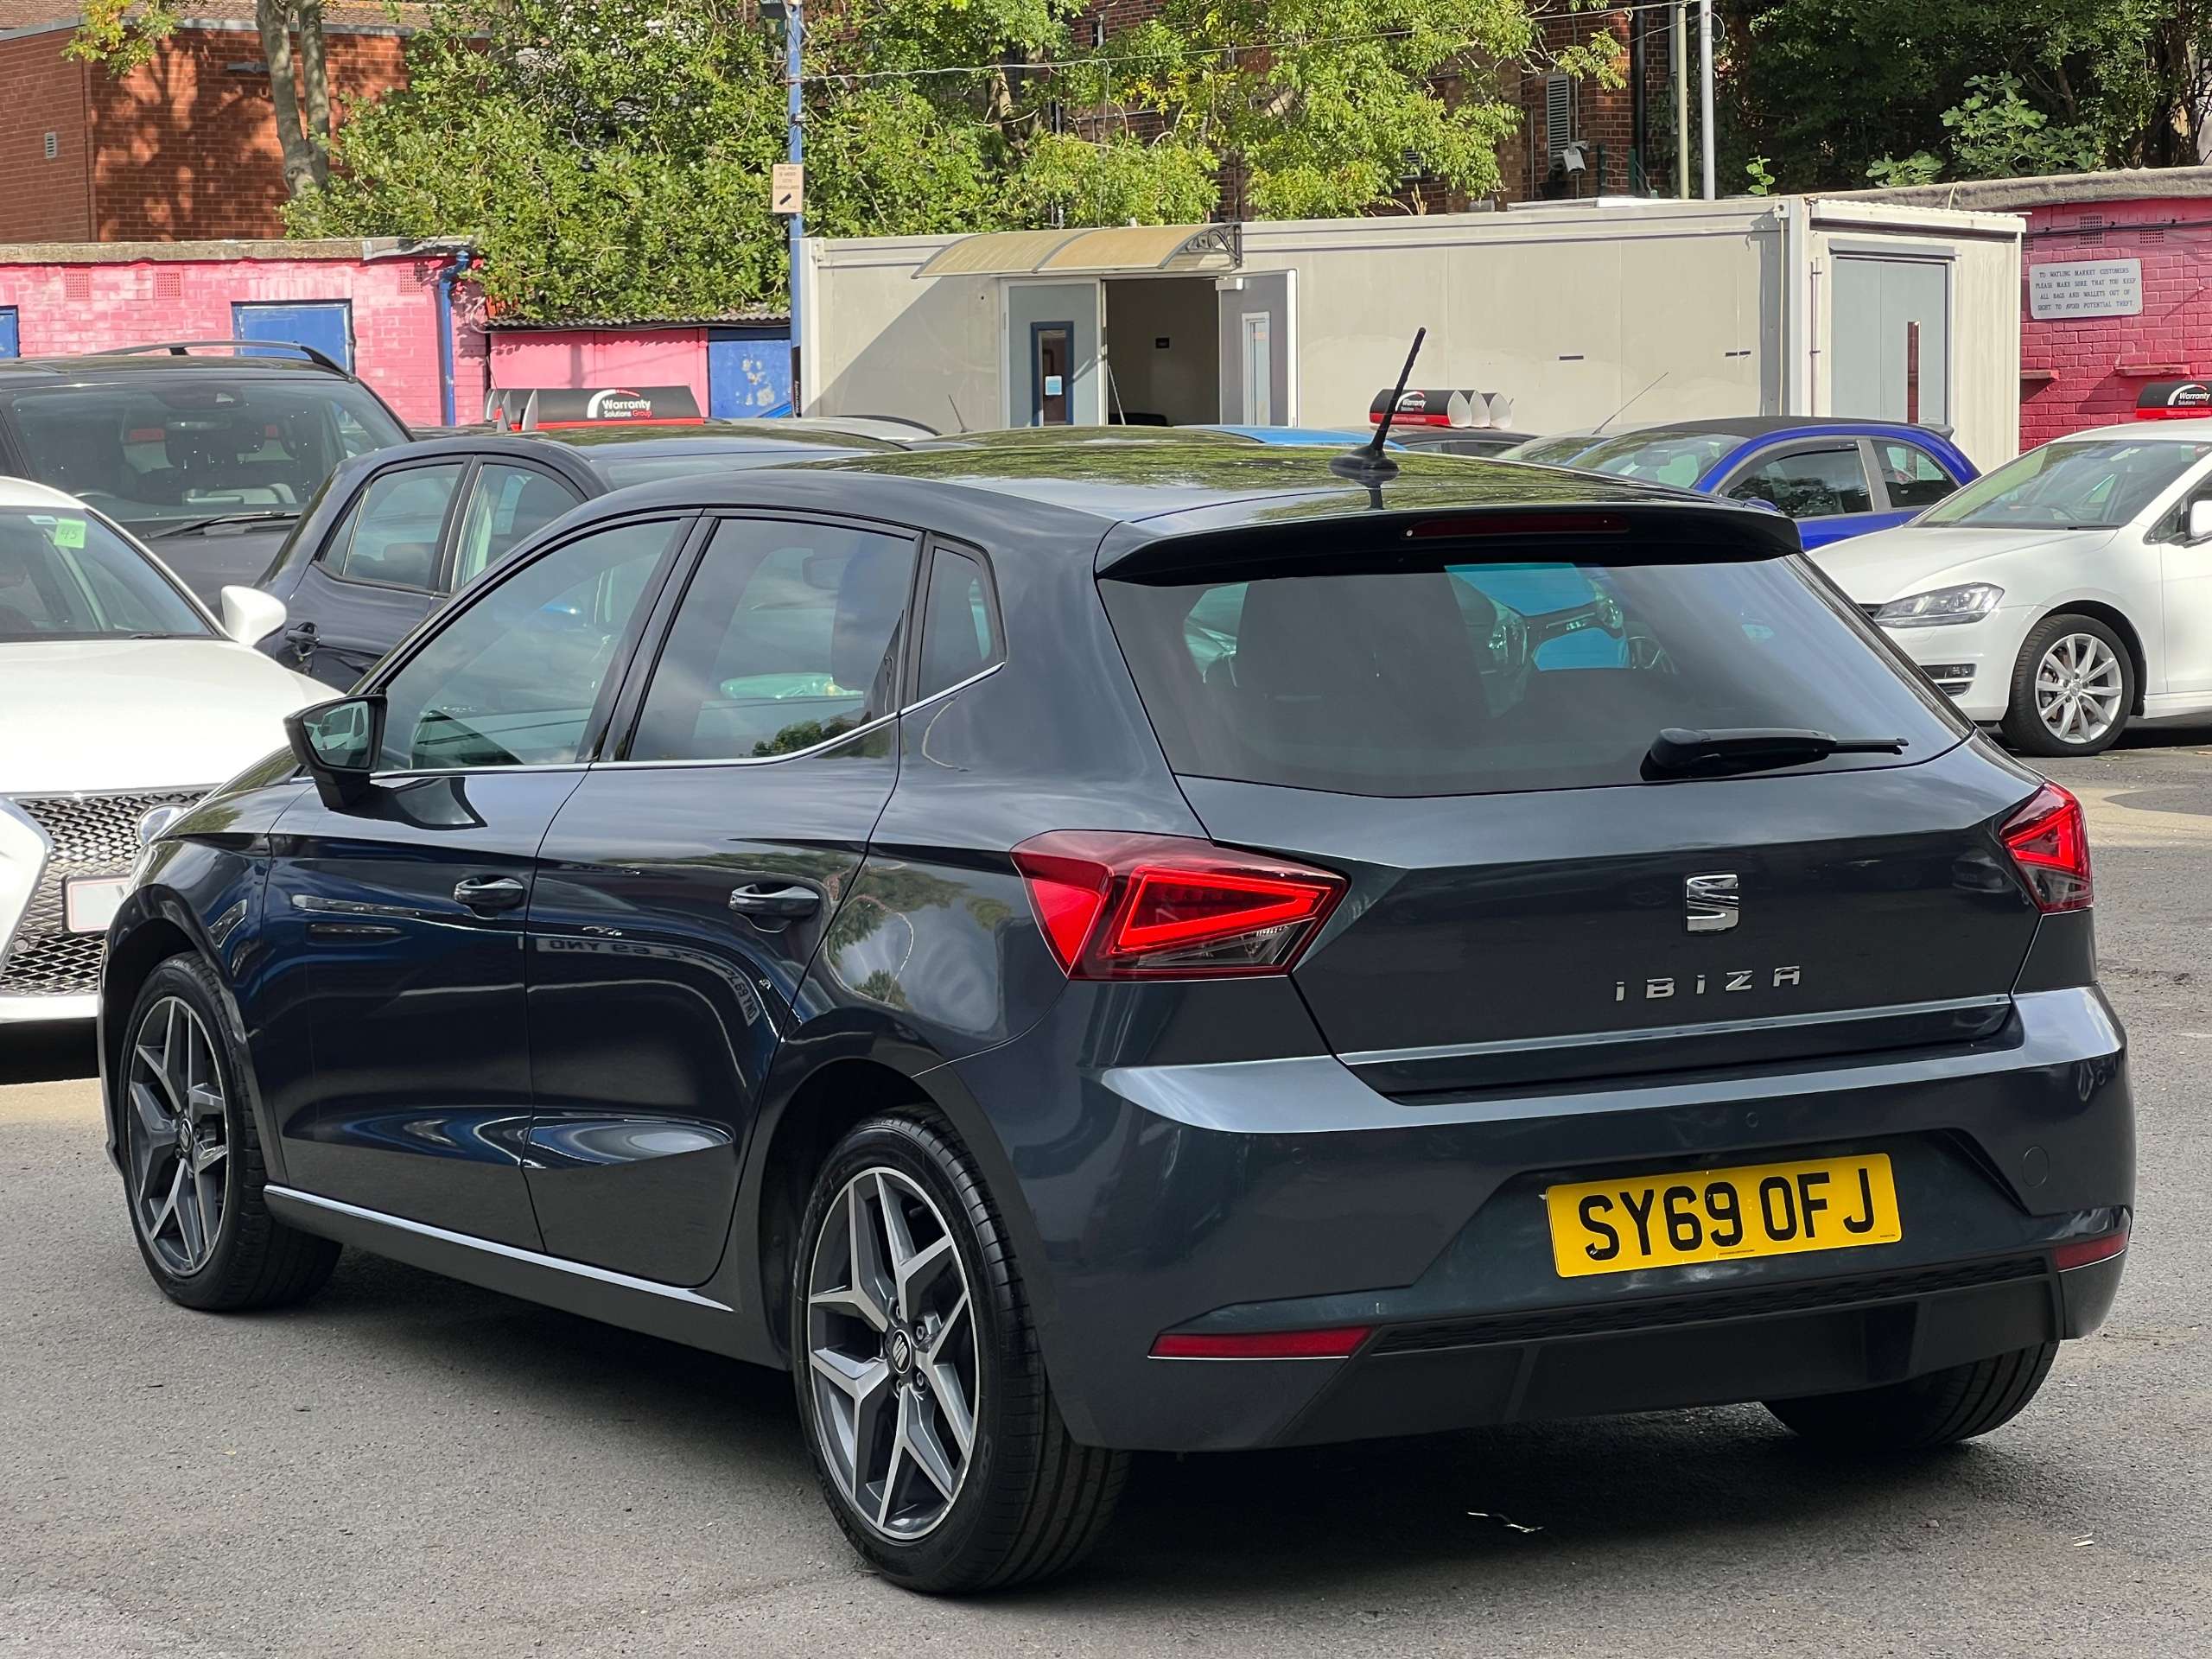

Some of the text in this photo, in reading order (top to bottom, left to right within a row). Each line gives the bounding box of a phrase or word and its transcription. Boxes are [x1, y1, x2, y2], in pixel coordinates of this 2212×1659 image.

[2179, 392, 2210, 401] Warranty
[602, 399, 651, 410] Warranty
[632, 410, 652, 418] Group
[1578, 1181, 1745, 1262] SY69
